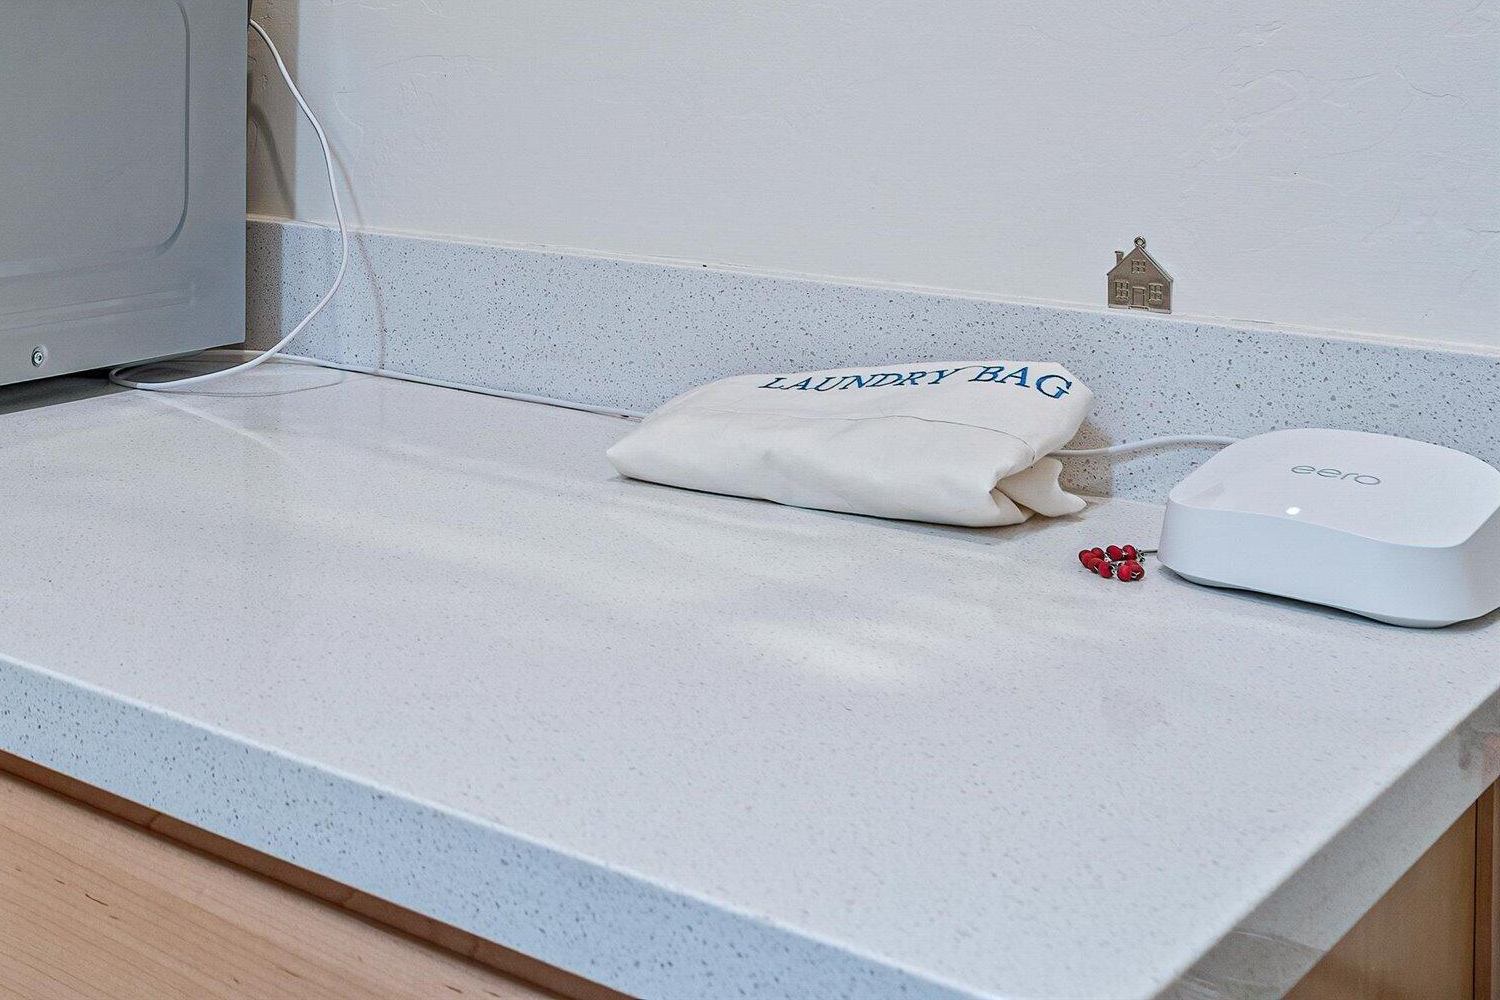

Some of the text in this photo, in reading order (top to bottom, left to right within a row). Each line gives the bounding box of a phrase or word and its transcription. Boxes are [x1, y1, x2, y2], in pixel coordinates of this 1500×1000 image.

[757, 365, 1073, 400] LAUNDRY BAG
[1291, 465, 1381, 486] eero
